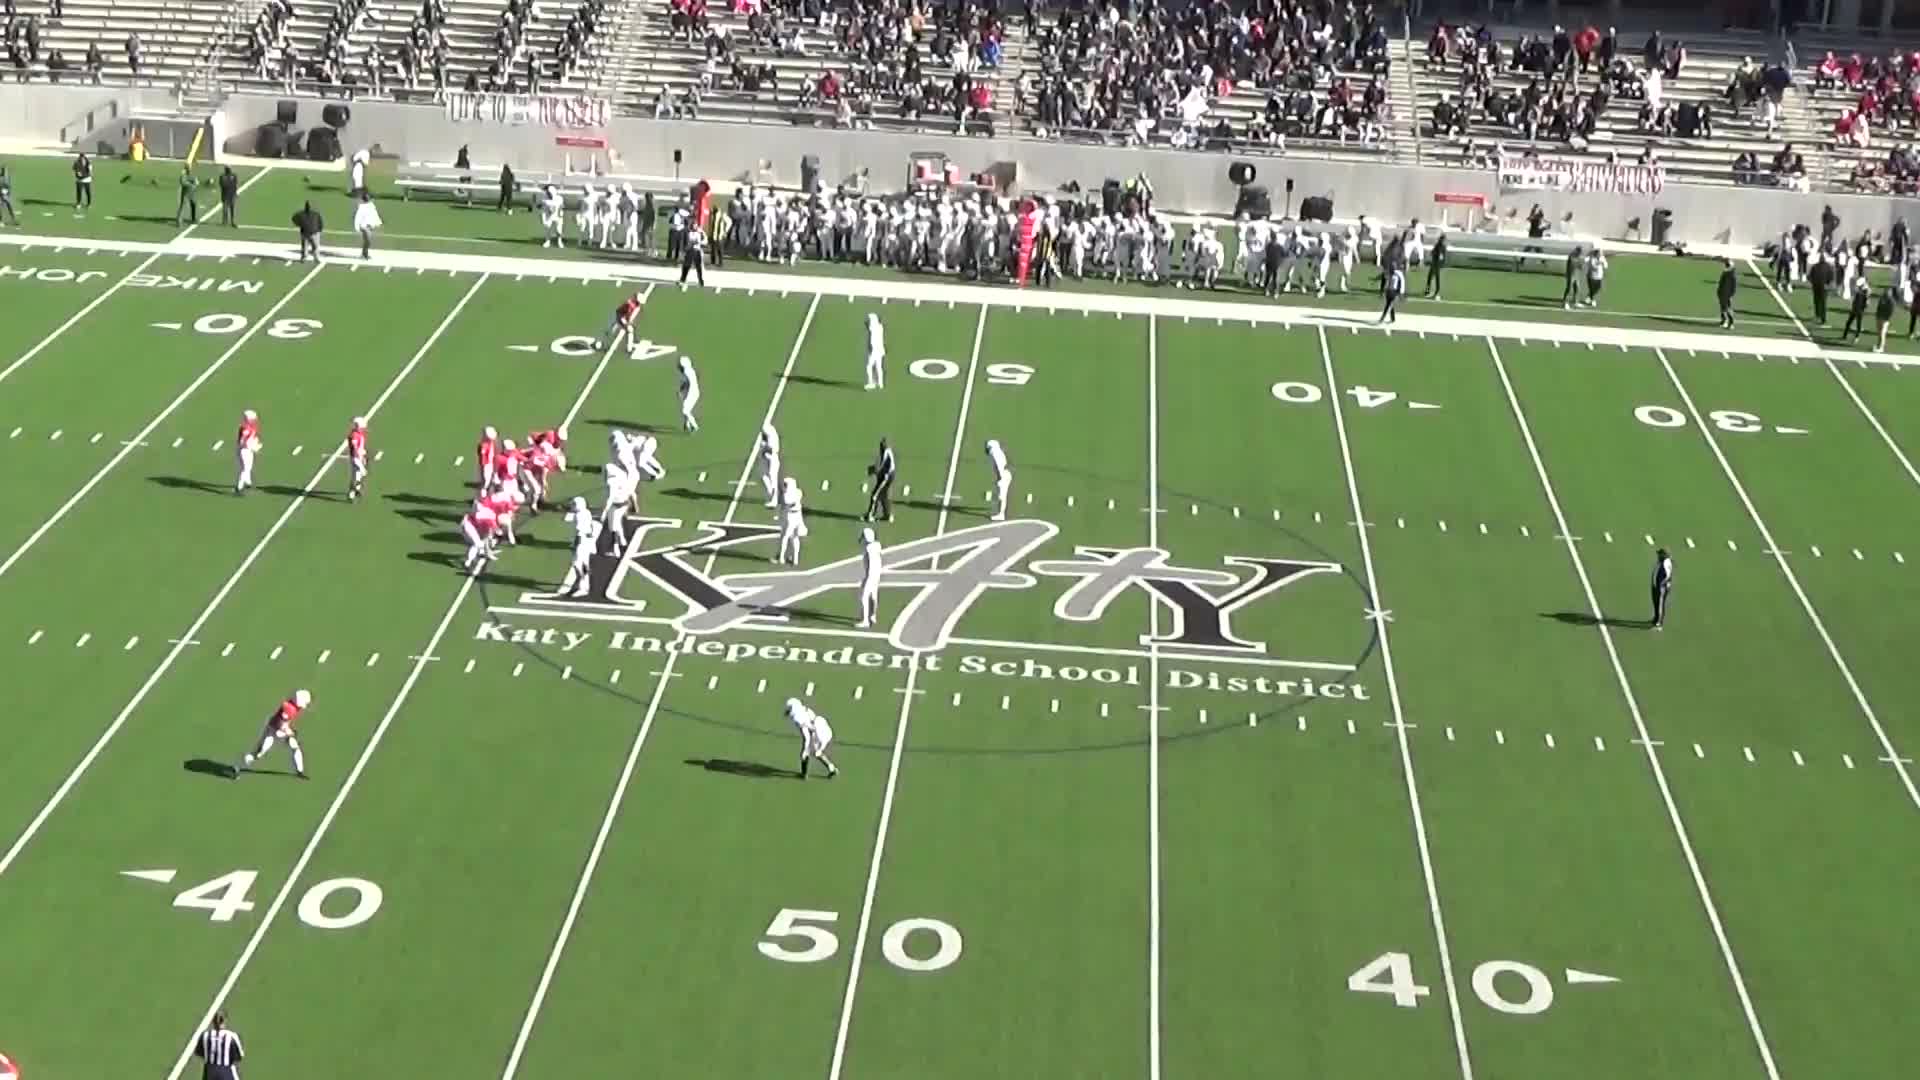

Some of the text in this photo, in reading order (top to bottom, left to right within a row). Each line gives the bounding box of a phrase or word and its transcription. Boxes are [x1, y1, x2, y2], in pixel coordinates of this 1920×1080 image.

[122, 273, 265, 294] MIKE
[473, 621, 1371, 701] Katy Independent School District
